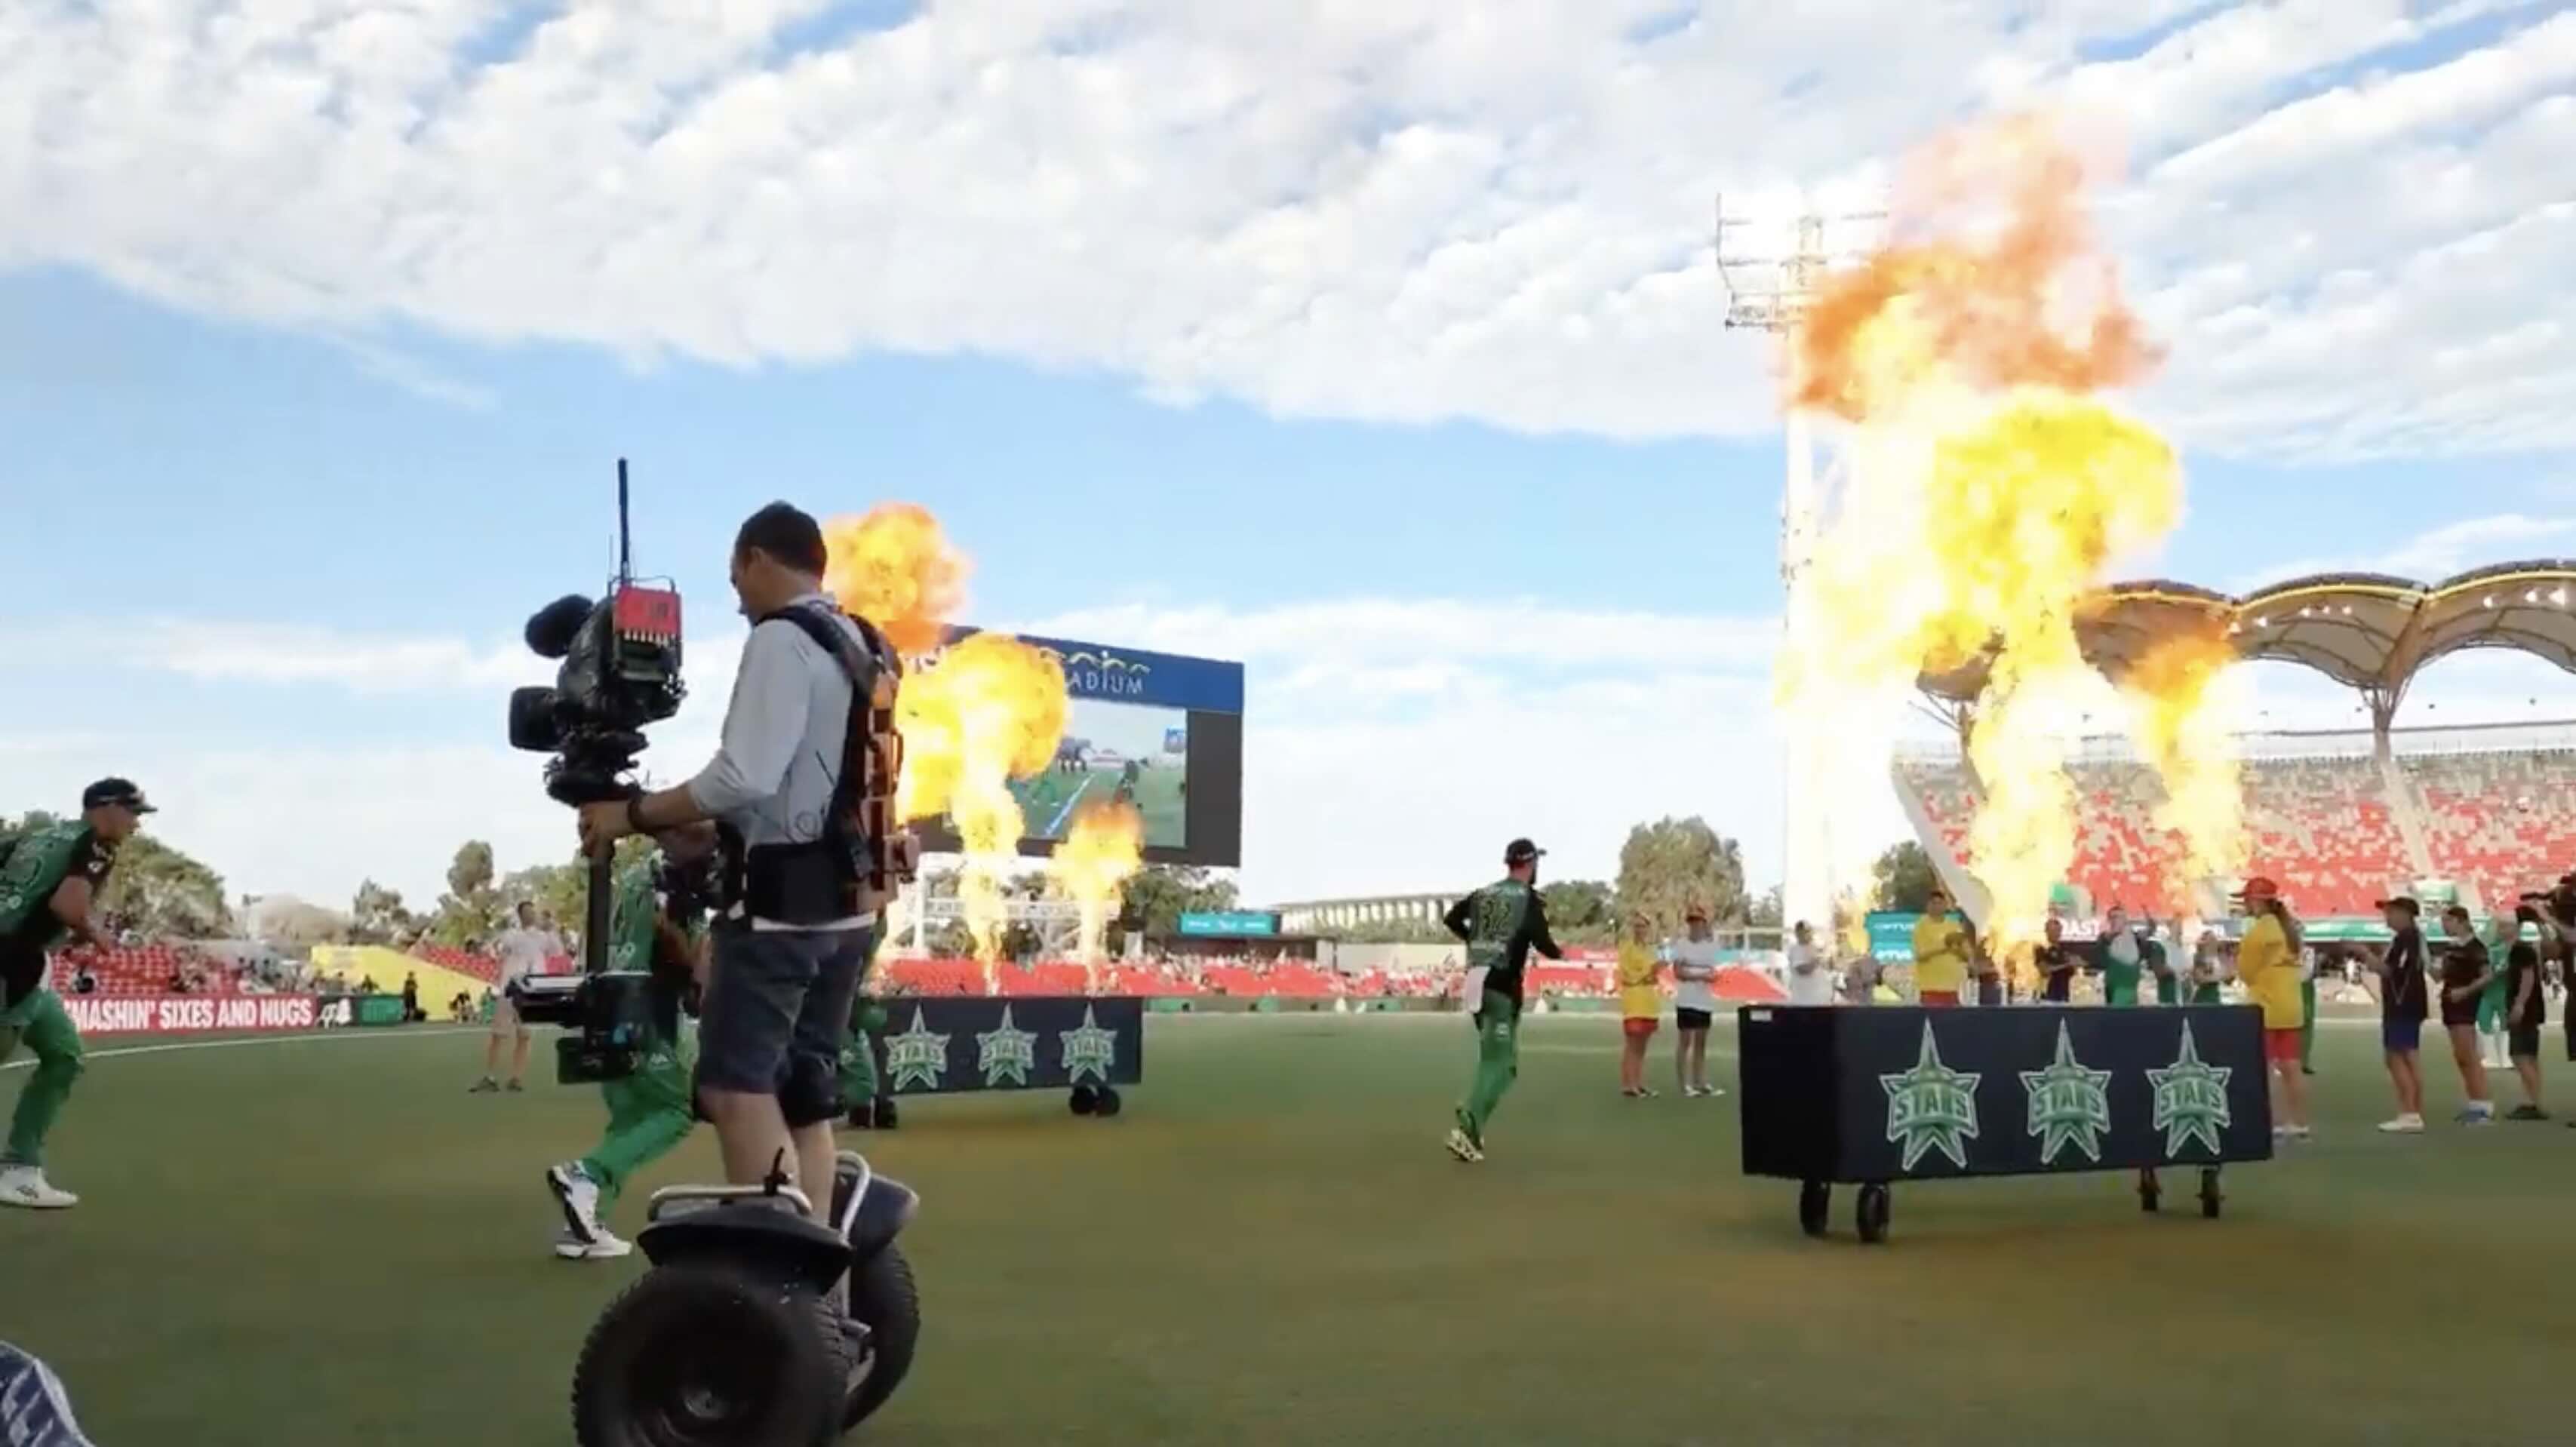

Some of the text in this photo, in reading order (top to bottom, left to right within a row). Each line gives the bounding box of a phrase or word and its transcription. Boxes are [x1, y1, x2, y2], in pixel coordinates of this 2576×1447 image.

[1065, 671, 1143, 693] ADIUM
[159, 997, 214, 1030] SIXES
[217, 998, 257, 1028] AND
[259, 997, 312, 1028] NUGS
